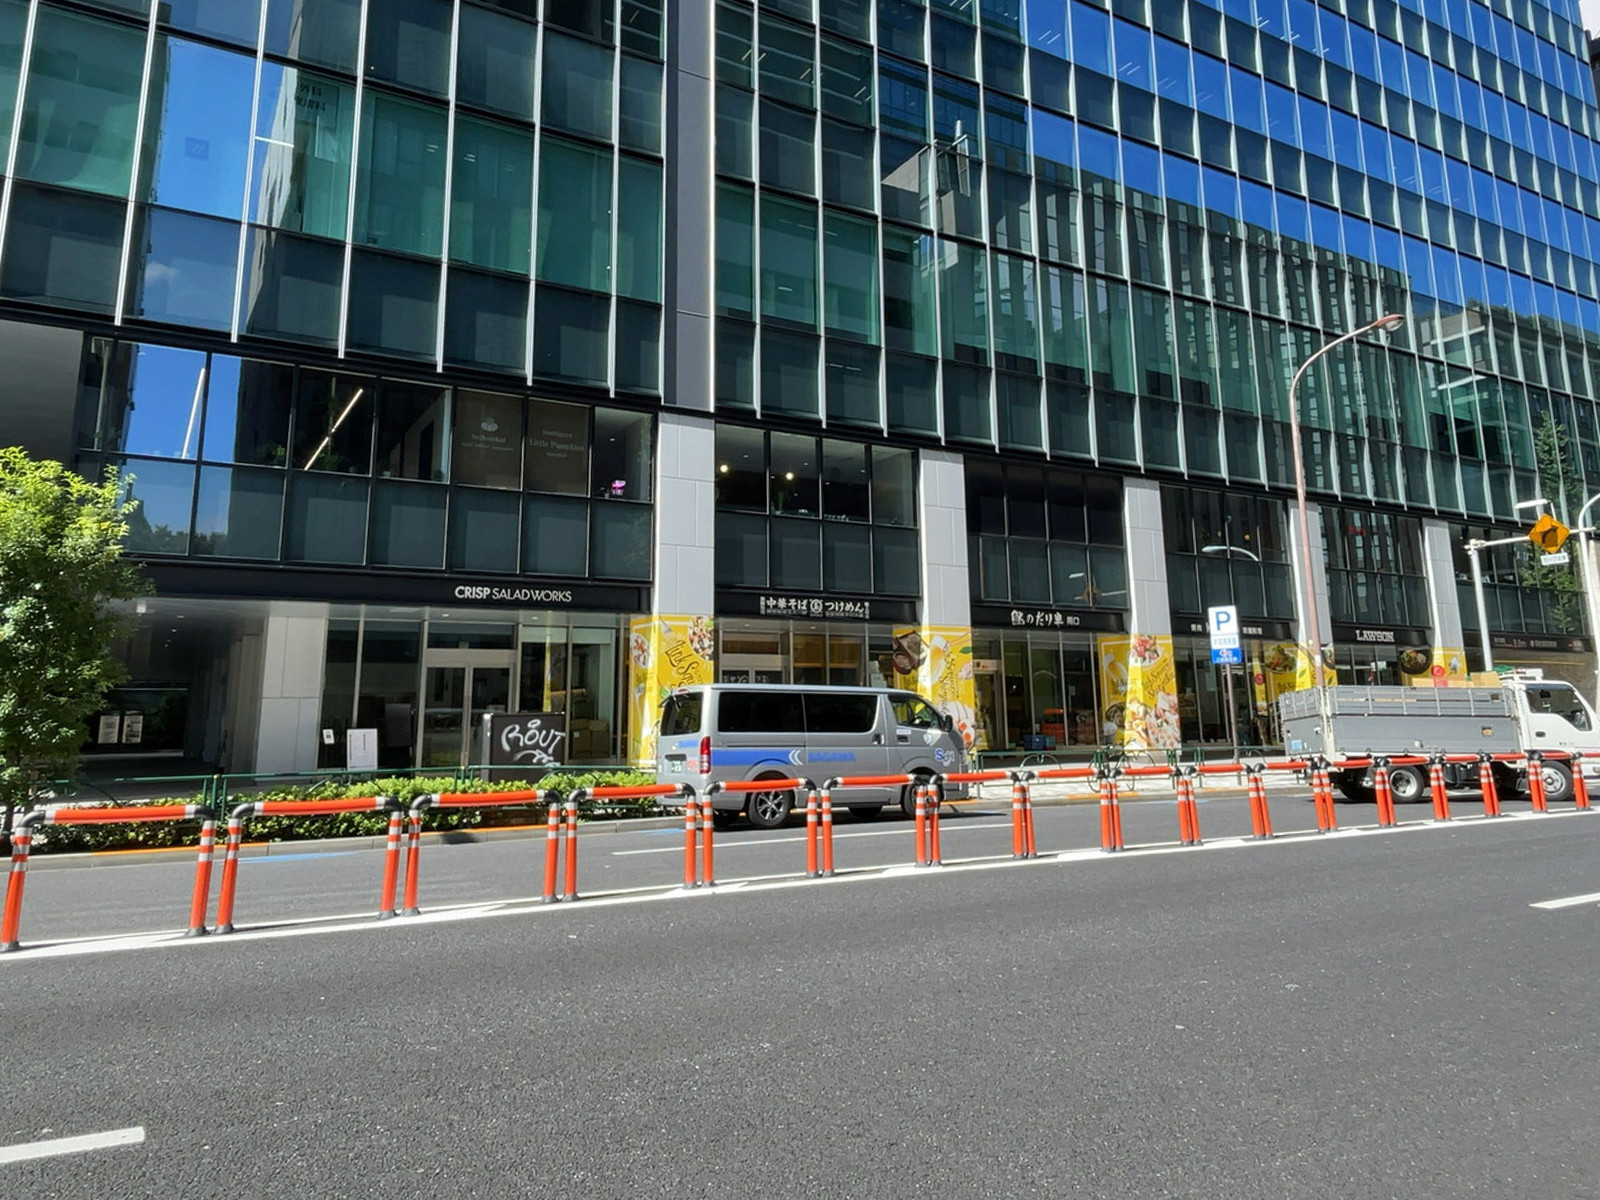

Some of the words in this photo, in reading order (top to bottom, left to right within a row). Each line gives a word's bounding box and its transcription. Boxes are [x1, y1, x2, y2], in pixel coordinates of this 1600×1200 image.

[454, 585, 491, 599] CRISP
[825, 602, 864, 613] つけめん
[1215, 611, 1231, 631] P
[1355, 629, 1395, 643] LAWSON
[664, 640, 693, 668] Link
